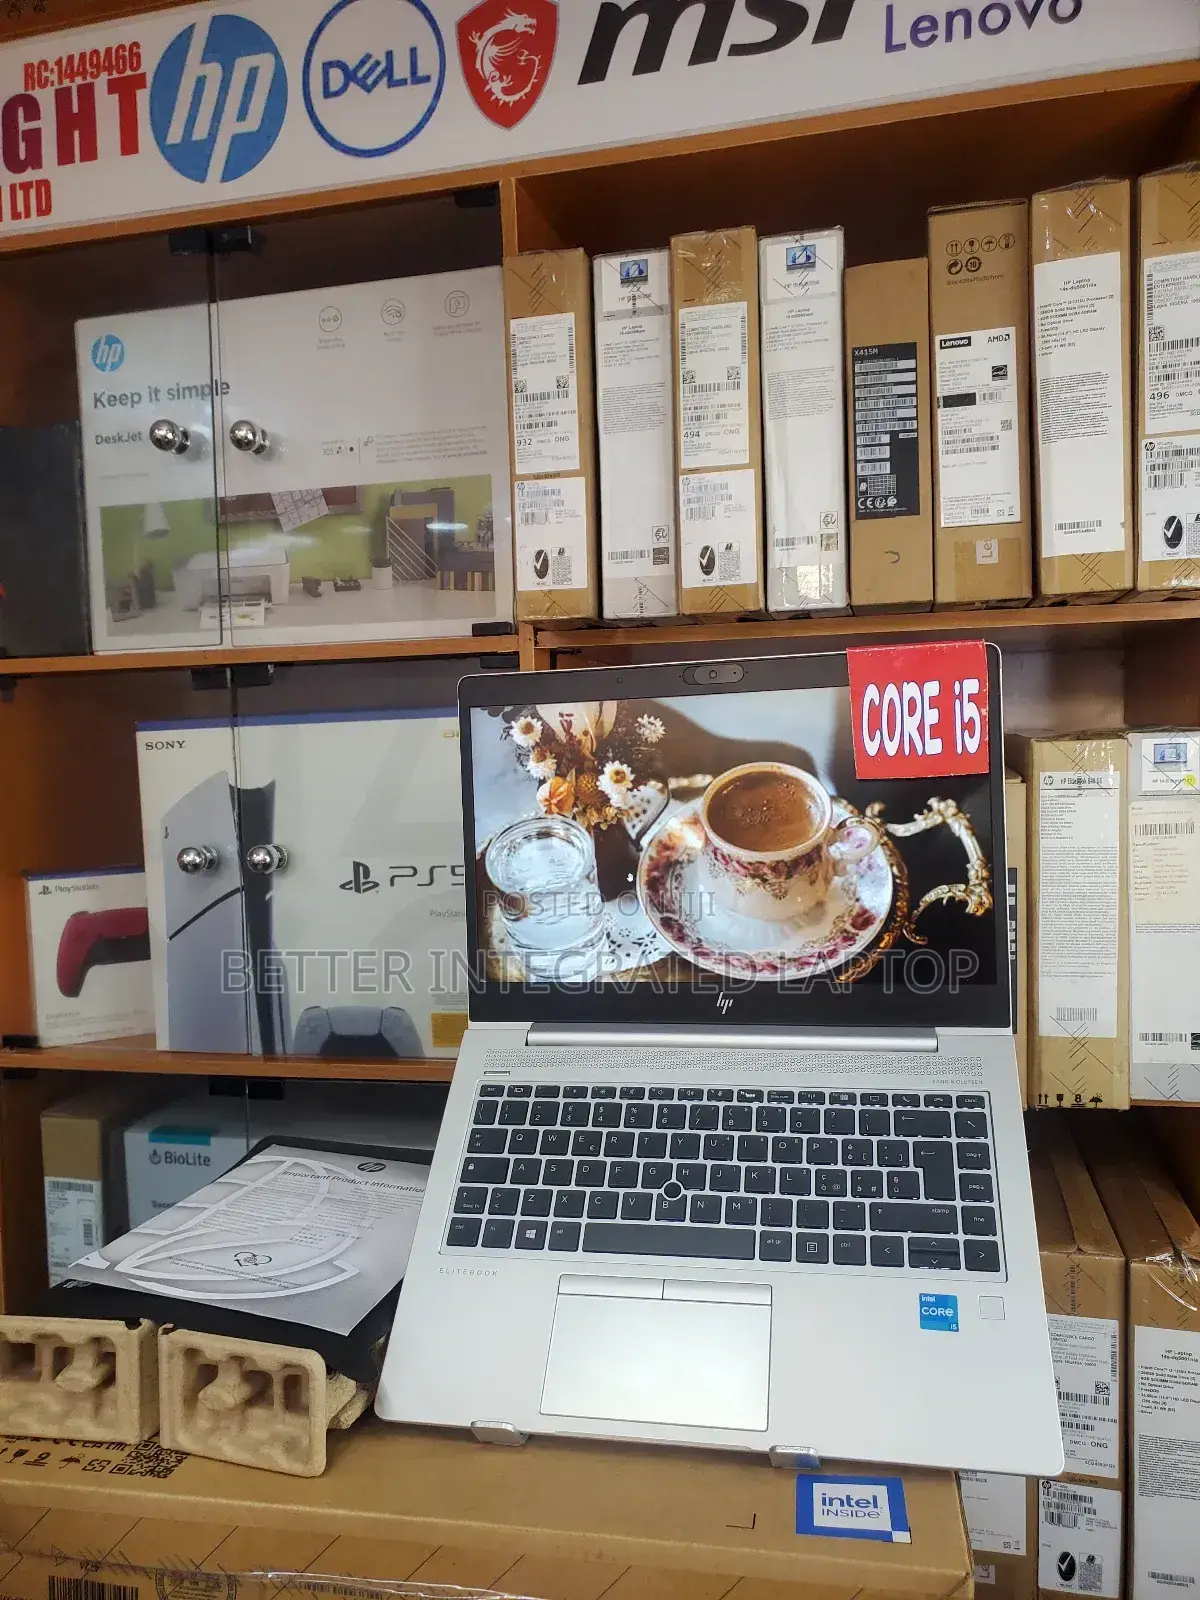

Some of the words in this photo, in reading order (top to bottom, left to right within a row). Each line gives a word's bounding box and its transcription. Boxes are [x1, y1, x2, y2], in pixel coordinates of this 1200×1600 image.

[884, 0, 1082, 53] Lenovo
[23, 41, 142, 92] RC:1449466
[322, 46, 431, 100] DELL
[165, 12, 277, 183] hp
[10, 179, 53, 220] LTD
[941, 338, 969, 348] Lenovo
[987, 334, 1004, 344] AMD
[854, 348, 879, 357] X415M
[93, 391, 142, 409] Keep
[148, 386, 161, 403] it
[166, 379, 231, 402] simple
[1149, 391, 1170, 400] 496
[95, 431, 143, 445] DeskJet
[683, 431, 700, 439] 494
[516, 438, 533, 446] 932
[861, 680, 942, 757] CORE
[954, 677, 982, 756] i5
[145, 740, 187, 751] SONY
[54, 883, 99, 894] PlayStation
[565, 1114, 572, 1122] 3
[515, 1133, 524, 1141] Q
[547, 1134, 558, 1142] W
[578, 1135, 586, 1143] E
[610, 1136, 618, 1144] R
[710, 1139, 717, 1147] U
[813, 1142, 820, 1150] P
[164, 1151, 211, 1167] BioLite
[517, 1163, 526, 1171] A
[550, 1164, 557, 1172] S
[614, 1166, 622, 1174] F
[649, 1167, 657, 1175] G
[682, 1168, 690, 1176] H
[716, 1170, 723, 1178] J
[751, 1171, 758, 1179] K
[786, 1172, 793, 1181] L
[282, 1170, 330, 1181] Important
[331, 1175, 369, 1186] Product
[831, 1183, 841, 1191] @
[527, 1194, 536, 1202] Z
[560, 1195, 569, 1204] X
[594, 1197, 602, 1205] C
[628, 1197, 636, 1206] V
[662, 1200, 669, 1209] B
[697, 1200, 705, 1209] N
[732, 1202, 741, 1210] M
[931, 1207, 950, 1215] stamp
[439, 1267, 498, 1276] ELITEBOOK
[921, 1294, 936, 1303] intel
[1090, 1440, 1108, 1449] ONG
[821, 1492, 878, 1509] intel
